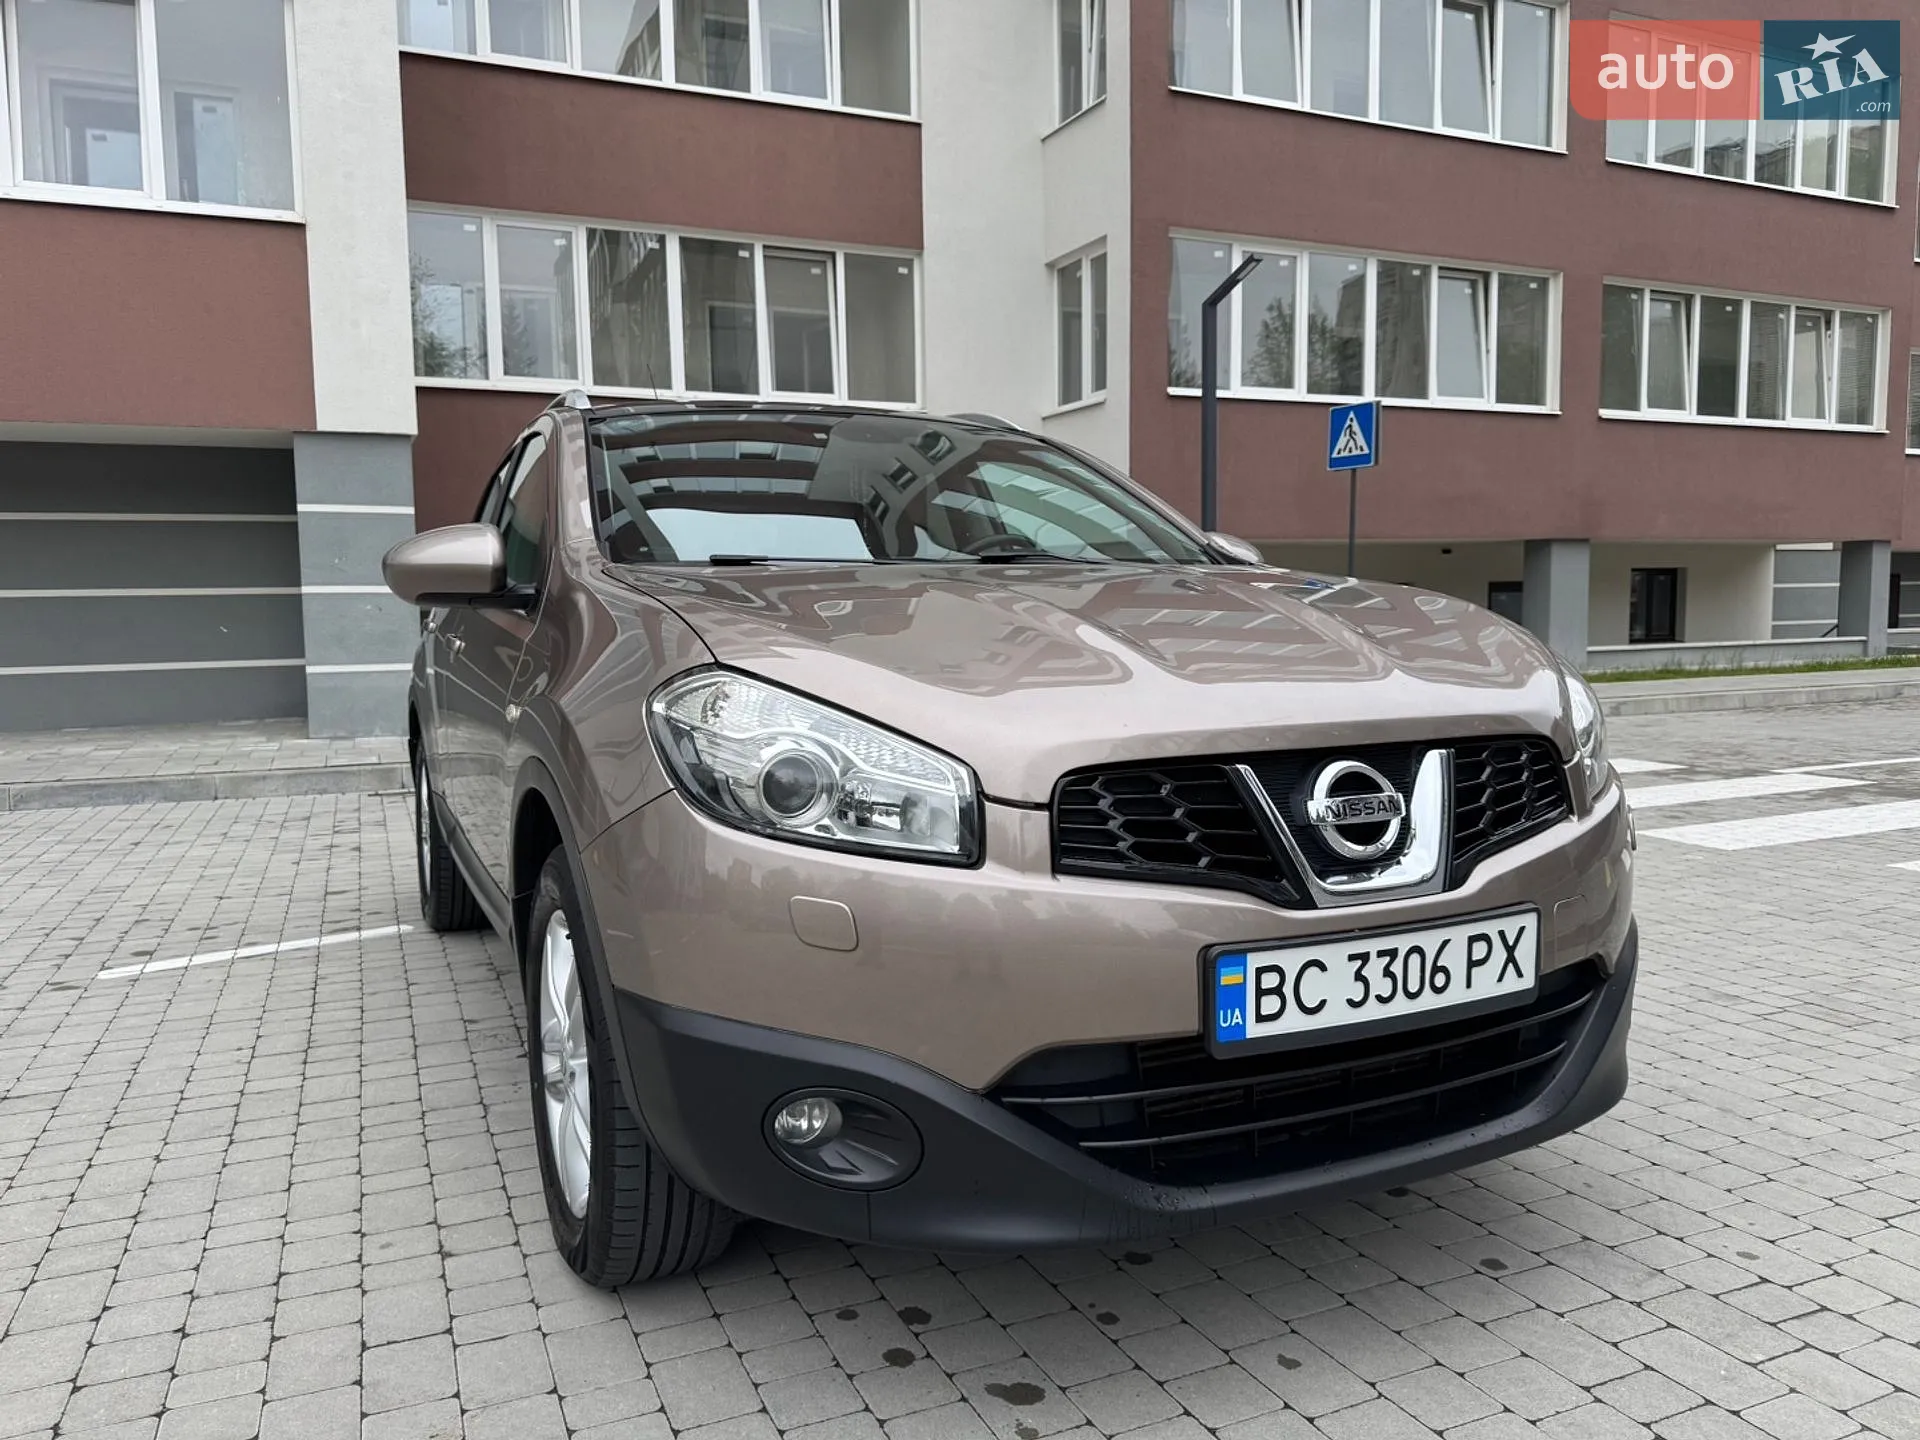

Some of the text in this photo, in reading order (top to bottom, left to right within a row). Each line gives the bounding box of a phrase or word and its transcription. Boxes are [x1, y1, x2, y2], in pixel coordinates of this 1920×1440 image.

[1324, 799, 1400, 820] NISSAN
[1253, 925, 1527, 1025] BC 3306 PX
[1219, 1007, 1244, 1028] UA
